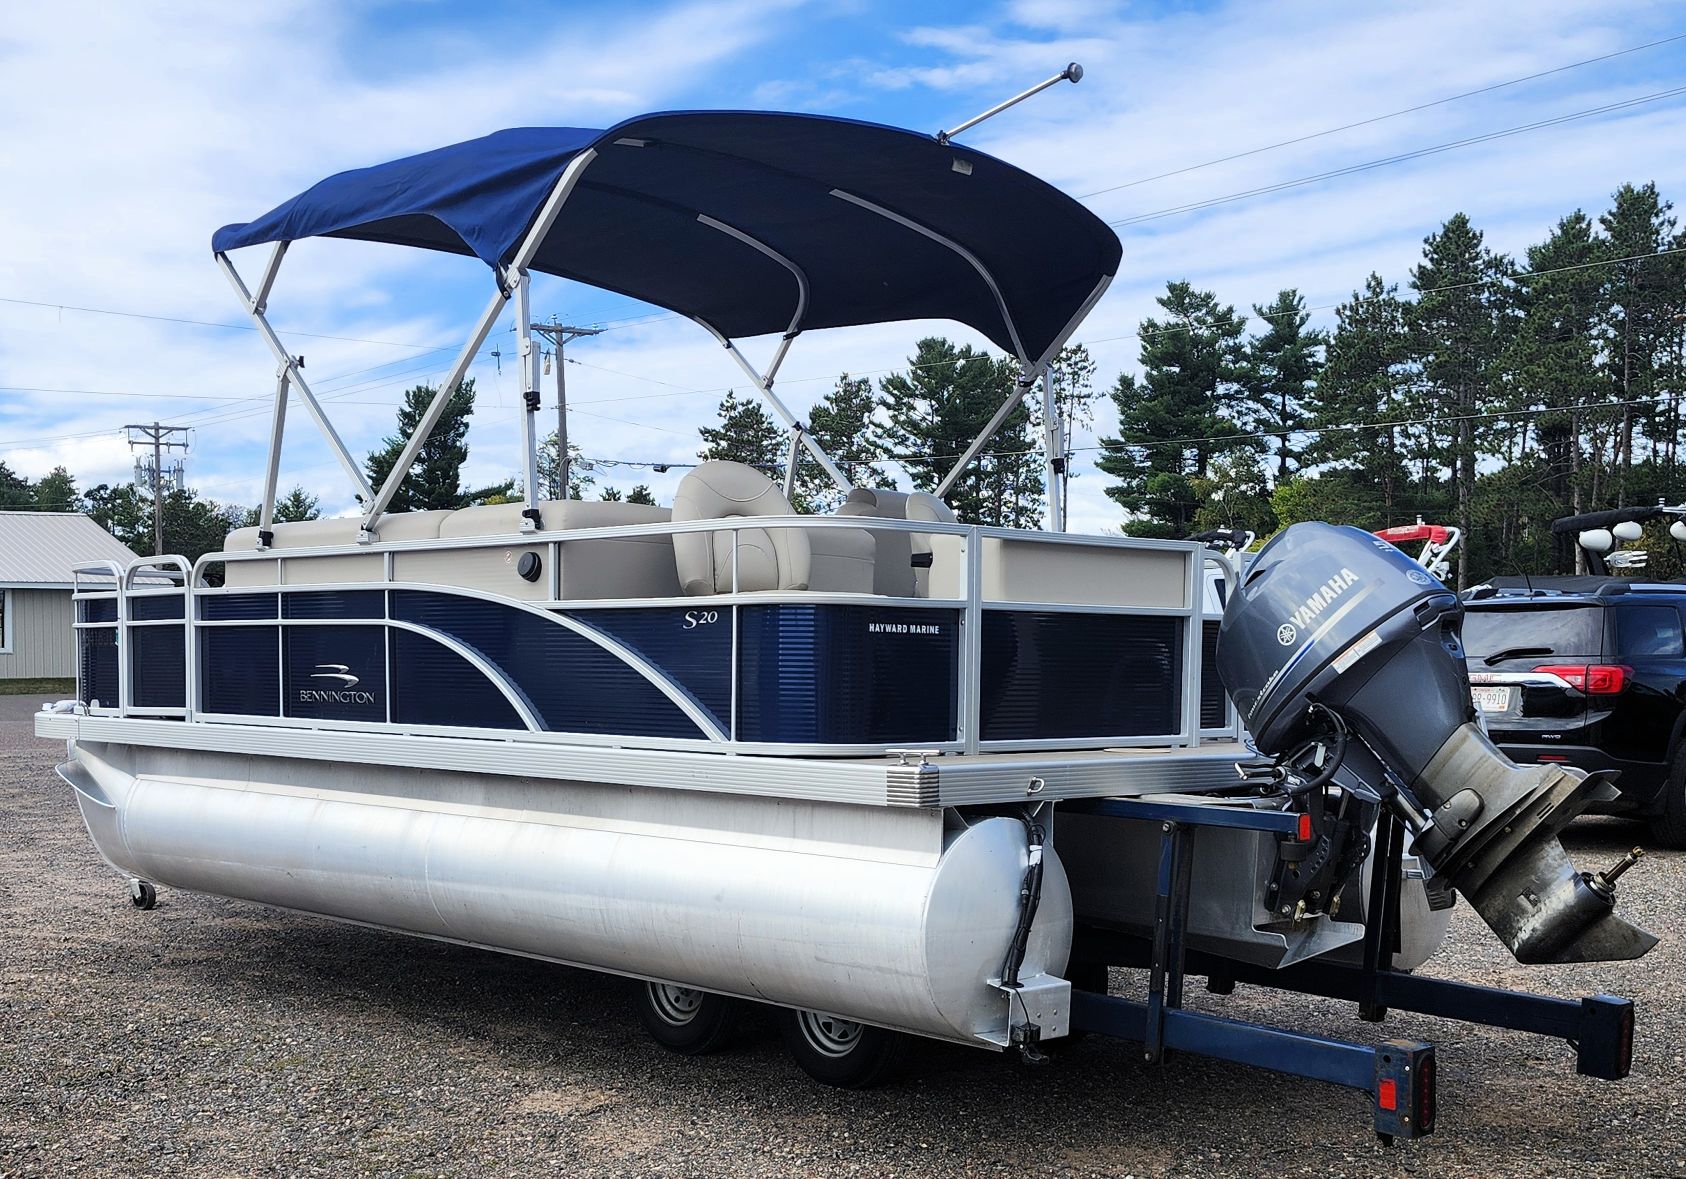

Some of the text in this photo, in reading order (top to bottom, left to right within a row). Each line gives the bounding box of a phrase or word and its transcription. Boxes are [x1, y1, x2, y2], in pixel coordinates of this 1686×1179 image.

[1289, 567, 1360, 630] YAMAHA
[868, 623, 940, 635] HAYWARD MARINE
[299, 690, 375, 704] BENNINGTON
